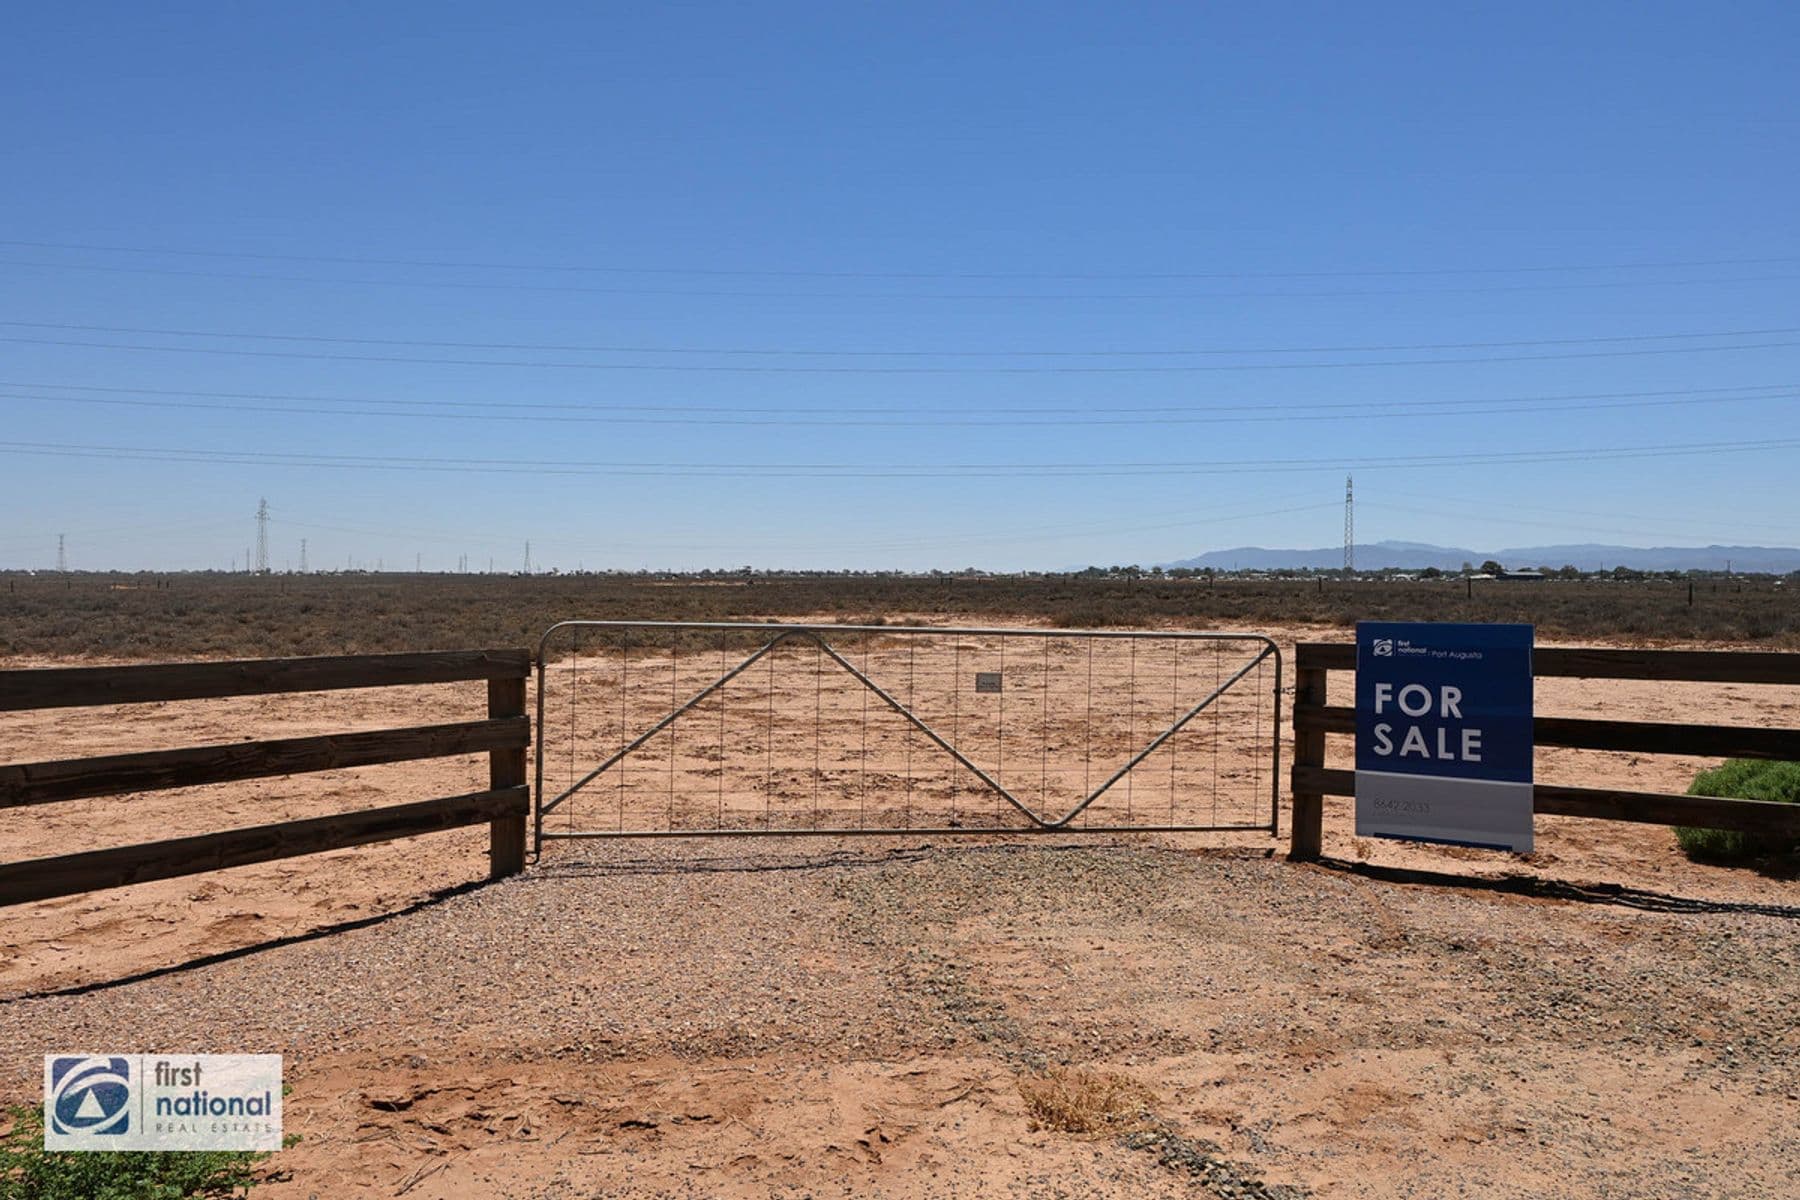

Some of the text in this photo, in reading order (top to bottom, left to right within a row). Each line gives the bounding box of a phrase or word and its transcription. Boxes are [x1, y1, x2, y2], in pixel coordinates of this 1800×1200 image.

[1449, 651, 1482, 660] Augusta
[1375, 683, 1462, 718] FOR
[1374, 723, 1482, 761] SALE
